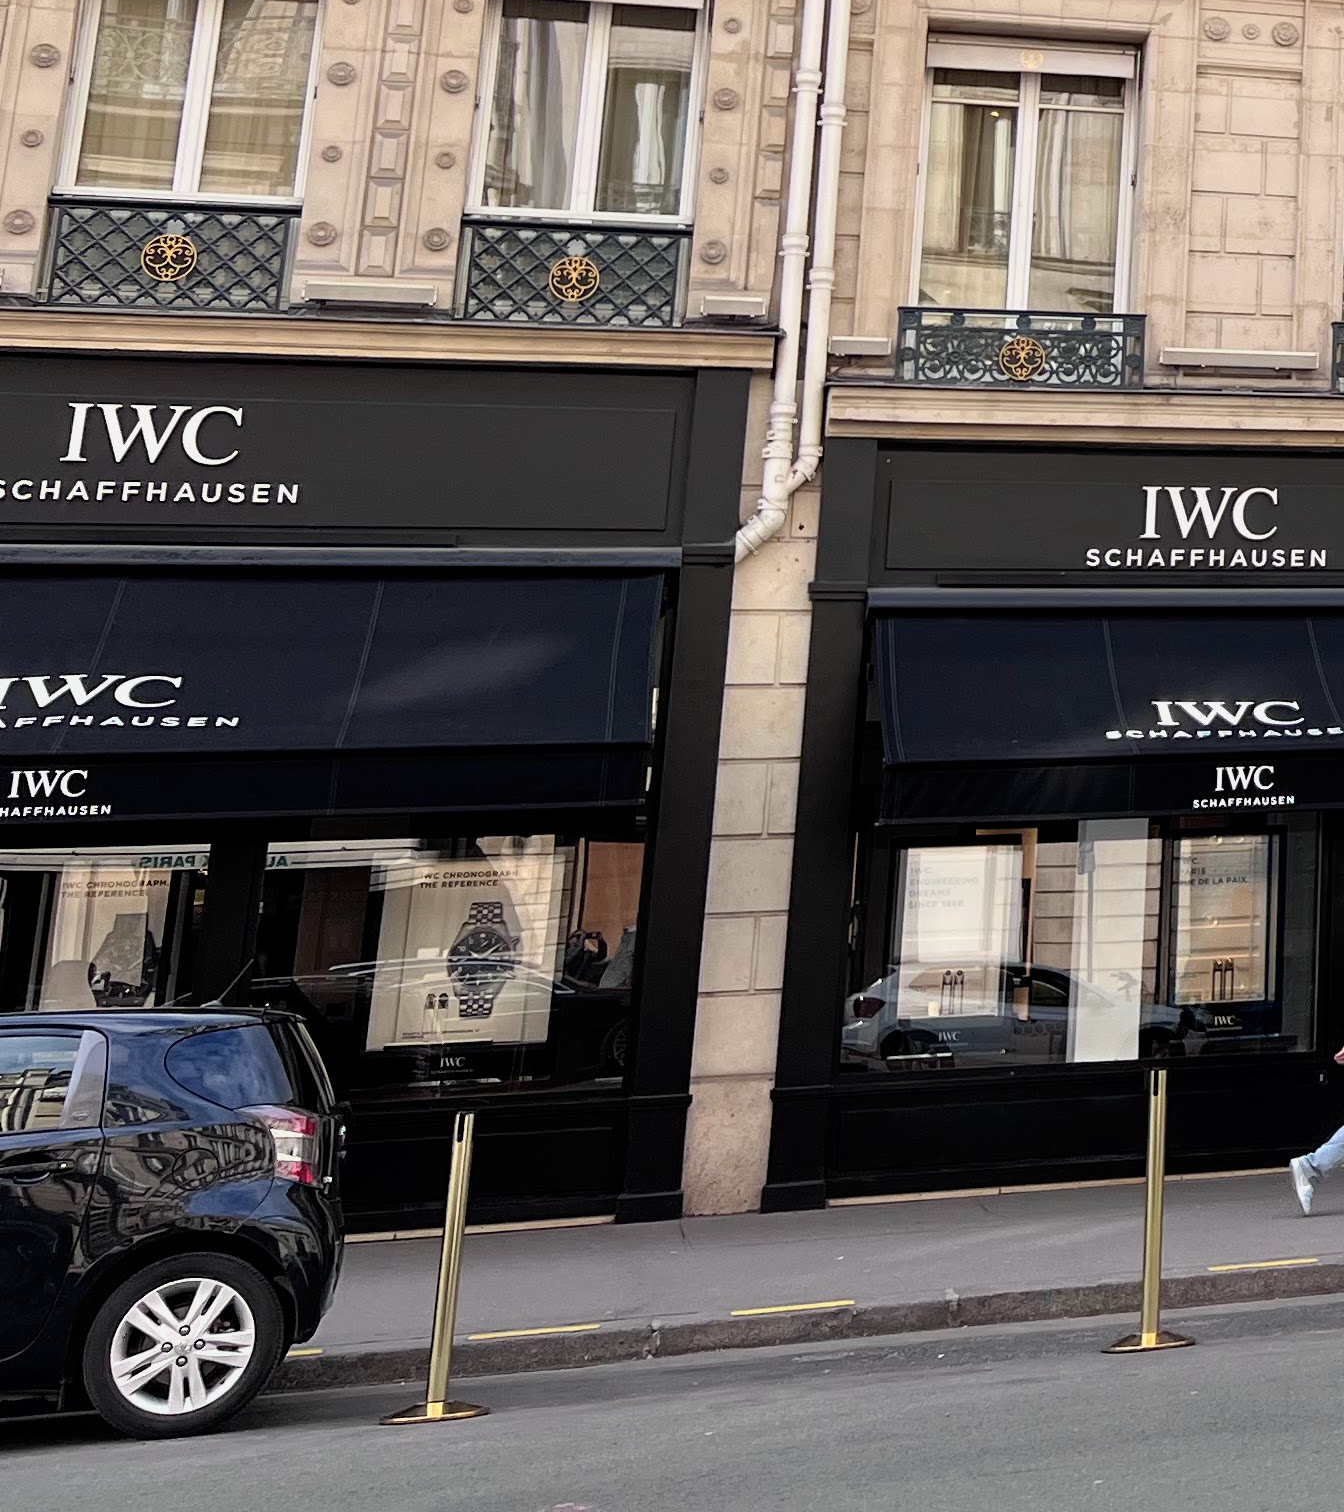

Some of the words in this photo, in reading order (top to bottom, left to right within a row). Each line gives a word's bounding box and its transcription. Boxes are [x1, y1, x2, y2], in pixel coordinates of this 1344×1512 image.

[59, 402, 243, 466] IWC
[1139, 485, 1278, 540] IWC
[1085, 548, 1327, 568] SCHAFFHAUSEN
[1151, 700, 1305, 726] IWC
[7, 769, 89, 799] IWC
[1214, 765, 1275, 792] IWC
[0, 804, 112, 818] HAFFHAUSEN
[1193, 795, 1295, 809] SCHAFFHAUSEN
